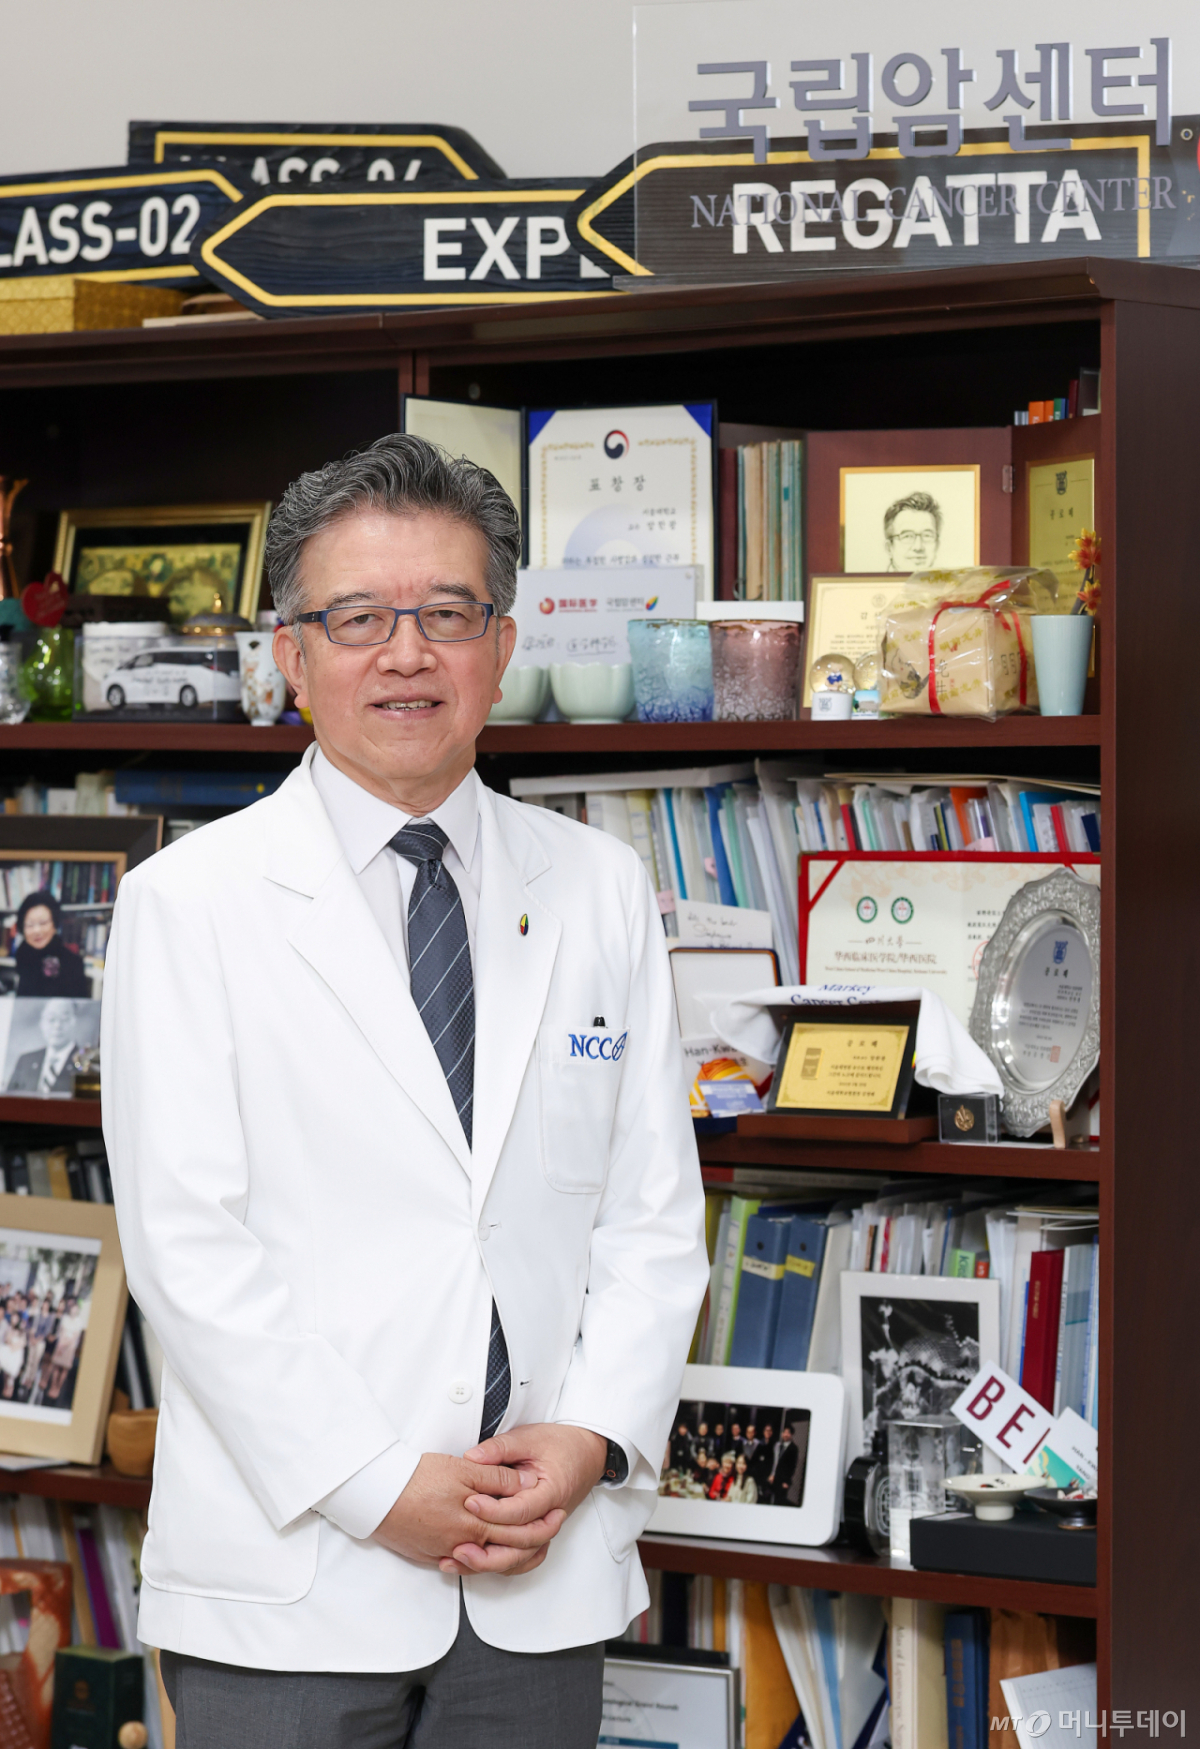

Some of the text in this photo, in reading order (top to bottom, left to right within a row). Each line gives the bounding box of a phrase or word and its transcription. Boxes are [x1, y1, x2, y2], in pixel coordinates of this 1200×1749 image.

[688, 37, 1171, 164] 국립암센터
[0, 193, 200, 268] ASS-02
[690, 174, 1177, 228] NATIONAL CANCER CENTER
[732, 169, 1102, 254] REGATTA
[568, 1033, 613, 1061] NCC
